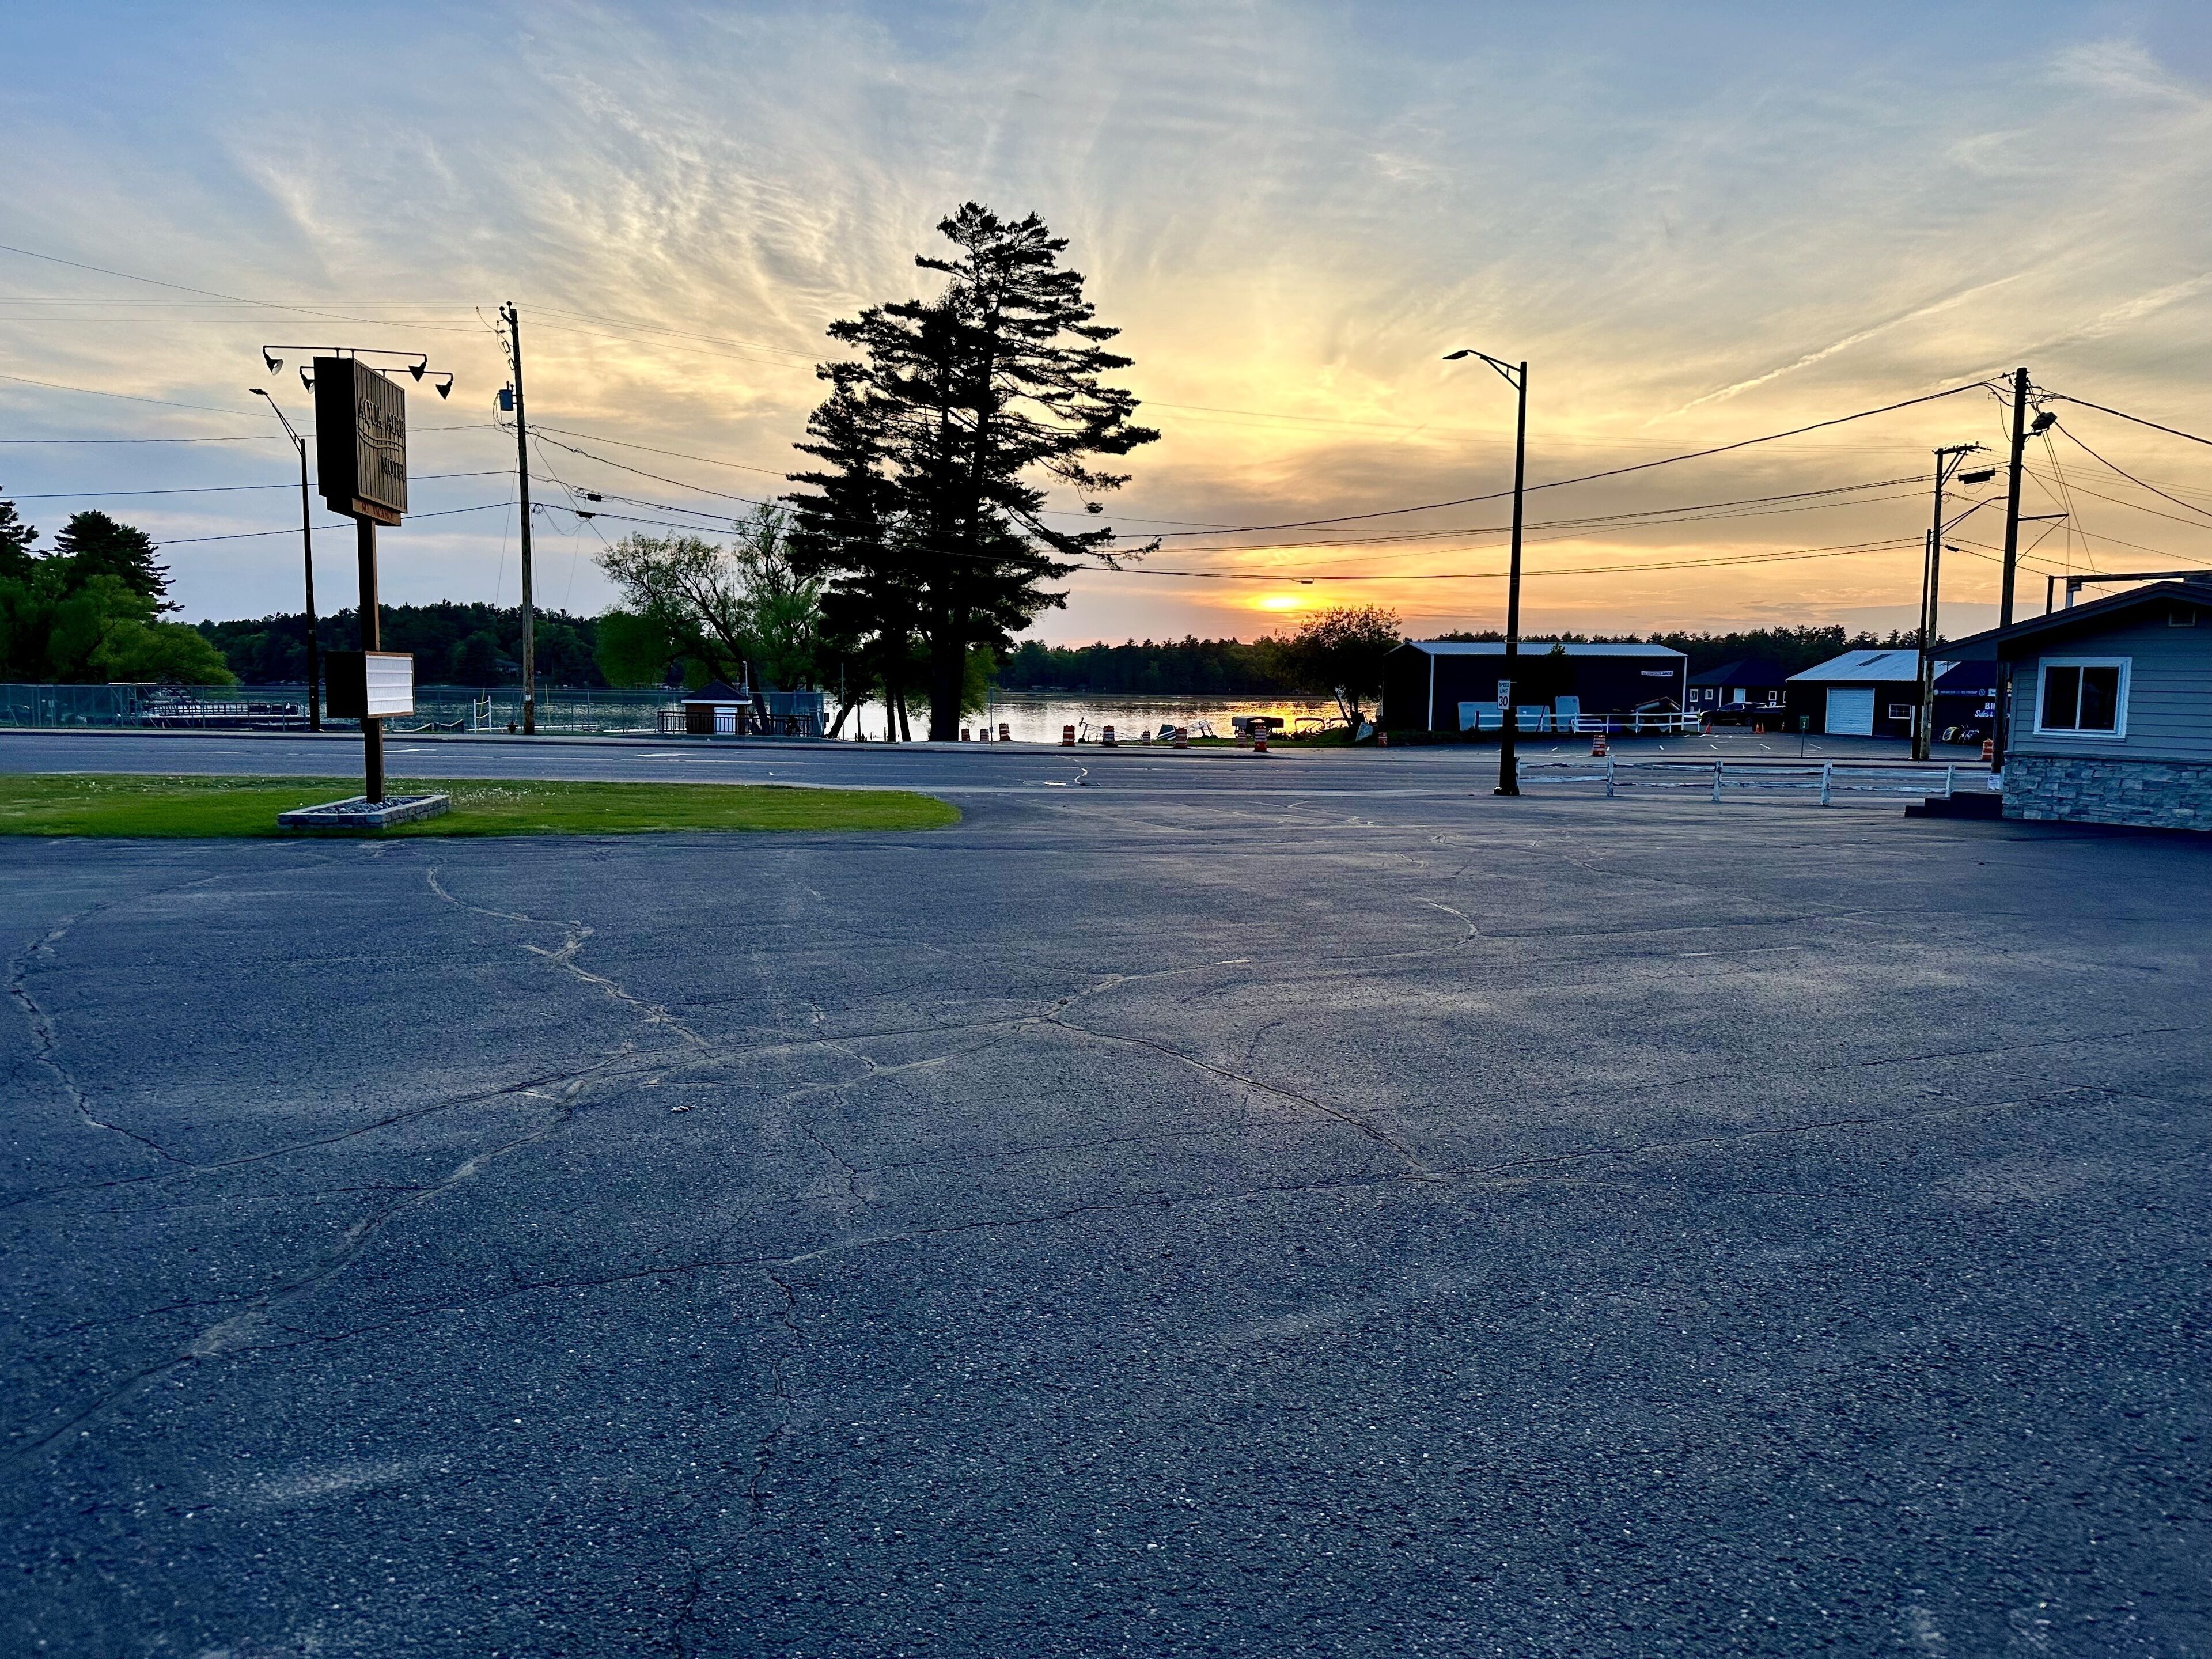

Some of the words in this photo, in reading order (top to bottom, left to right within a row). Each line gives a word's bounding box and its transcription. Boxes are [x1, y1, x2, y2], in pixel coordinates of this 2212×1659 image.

[359, 396, 383, 429] AQUA
[381, 455, 406, 481] MOTEL
[361, 502, 369, 513] NO
[373, 506, 393, 521] VACANCY
[1499, 695, 1508, 707] 30
